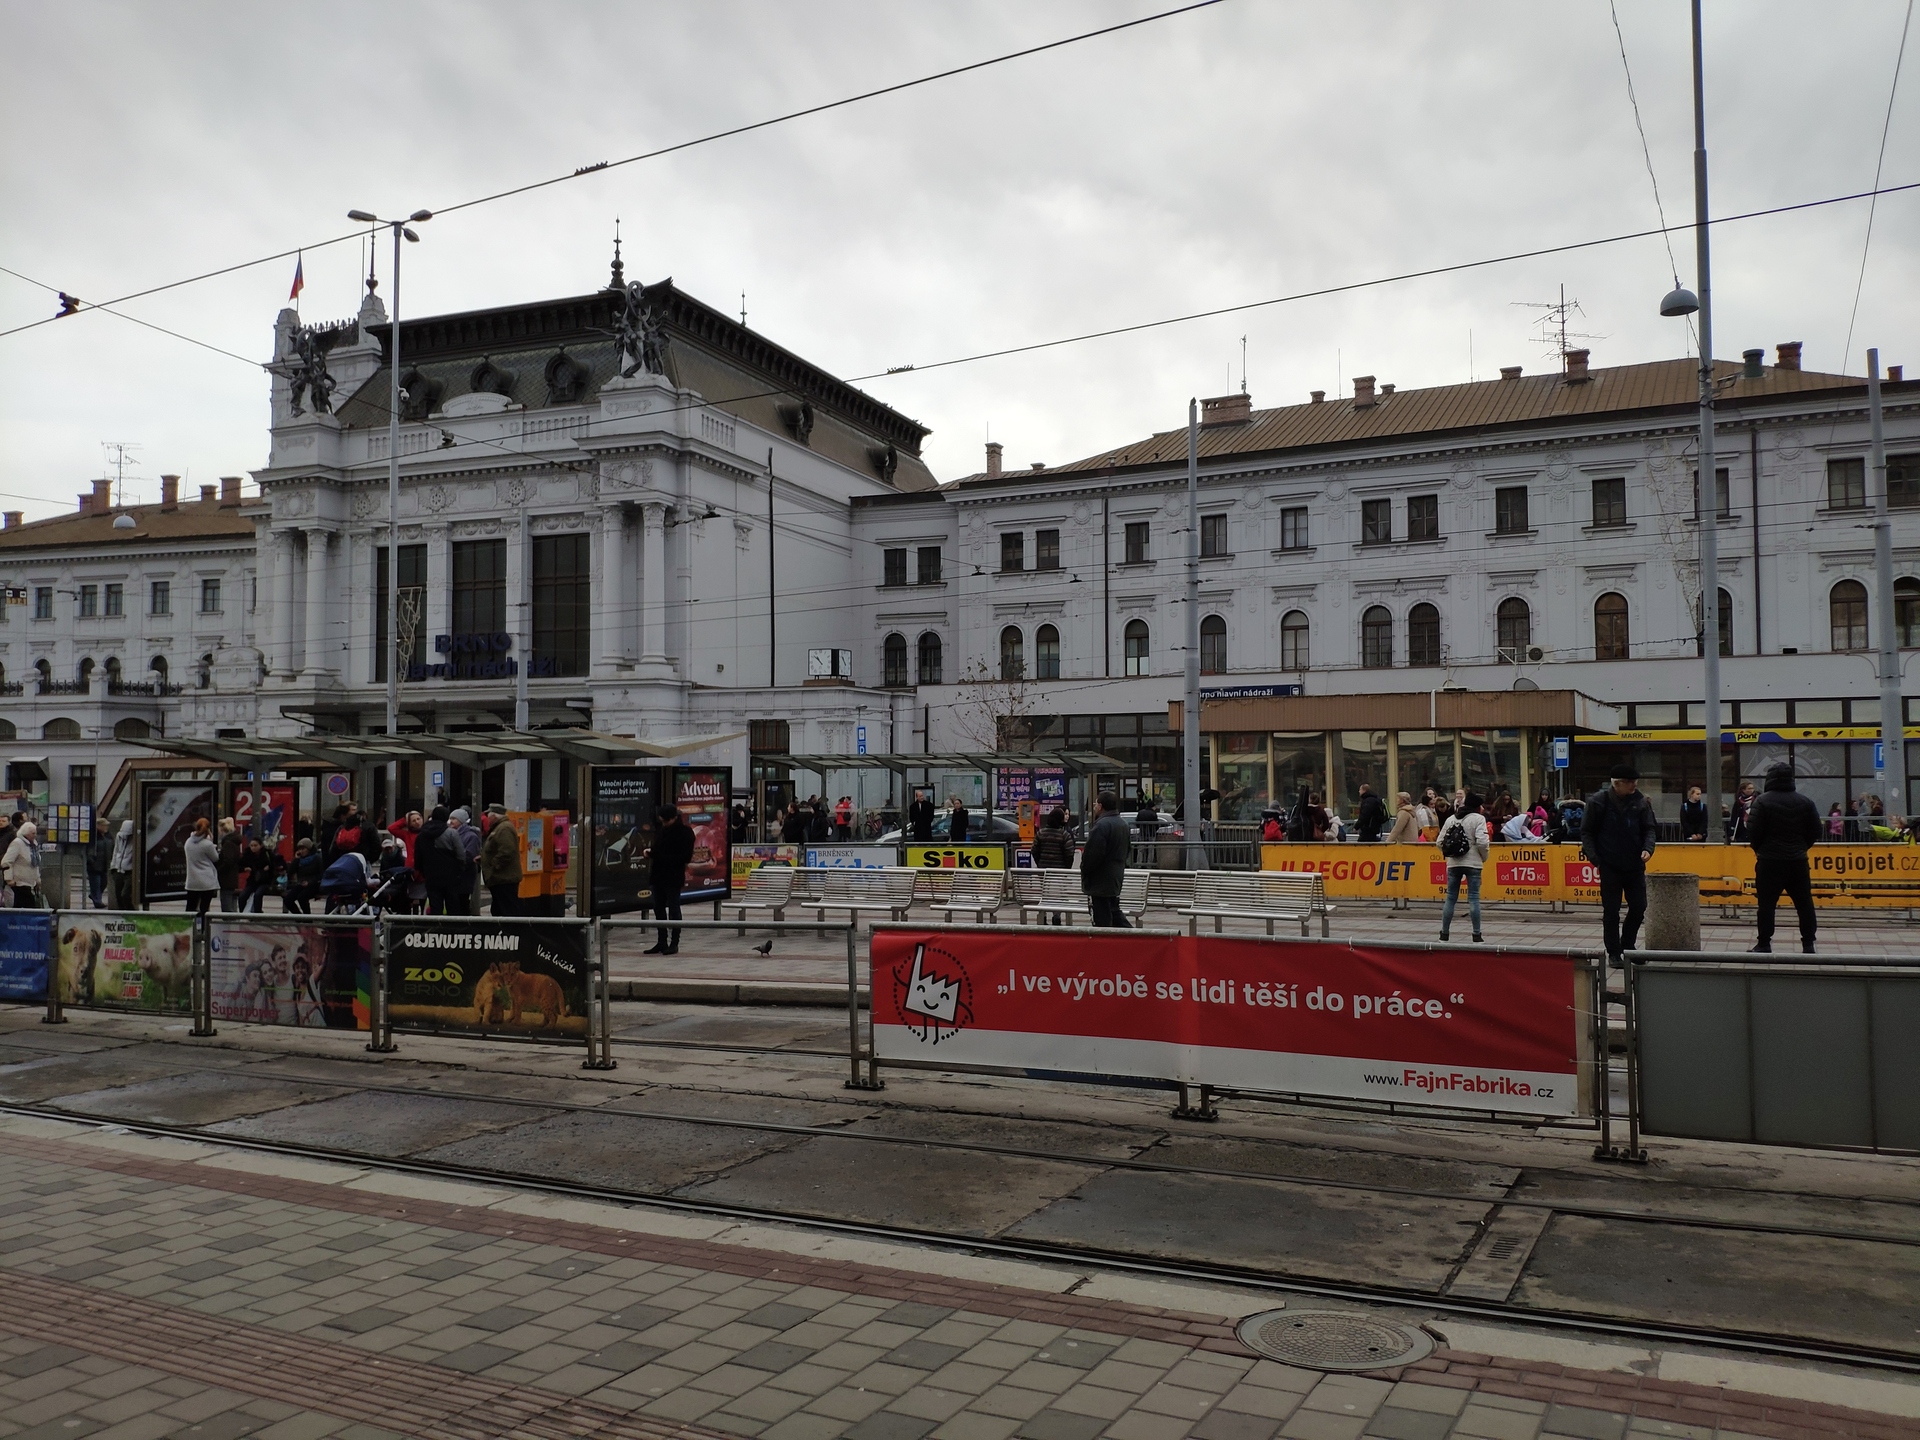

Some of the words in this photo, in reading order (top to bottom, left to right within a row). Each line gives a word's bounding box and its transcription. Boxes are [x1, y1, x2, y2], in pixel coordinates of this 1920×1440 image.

[435, 632, 512, 652] BRNO
[1217, 689, 1242, 698] hlavní
[1244, 688, 1274, 697] nádraží
[1621, 732, 1653, 740] MARKET
[619, 788, 629, 796] být
[681, 781, 721, 796] Advent
[818, 849, 854, 857] BRNĚNSKÝ
[1512, 848, 1546, 861] VÍDNĚ
[1501, 873, 1509, 881] od
[1511, 866, 1536, 881] 175
[1537, 873, 1545, 881] Kč
[1517, 887, 1542, 895] denně
[1574, 888, 1583, 896] 3x
[1586, 888, 1602, 896] den
[404, 932, 474, 950] OBJEVUJTE
[474, 935, 482, 950] S
[484, 930, 520, 951] NÁMI
[0, 949, 15, 959] NÍKY
[24, 950, 46, 960] VÝROBY
[536, 943, 551, 960] Vaše
[211, 989, 240, 1000] Language
[404, 983, 461, 997] BRNO
[1023, 975, 1051, 993] ve
[1057, 971, 1148, 1001] výrobě
[1155, 981, 1184, 1001] se
[1191, 978, 1235, 1005] lidi
[1243, 980, 1297, 1008] těší
[1305, 985, 1344, 1012] do
[211, 1001, 280, 1019] Superpower
[1363, 1068, 1555, 1100] www.FajnFabrika.cz
